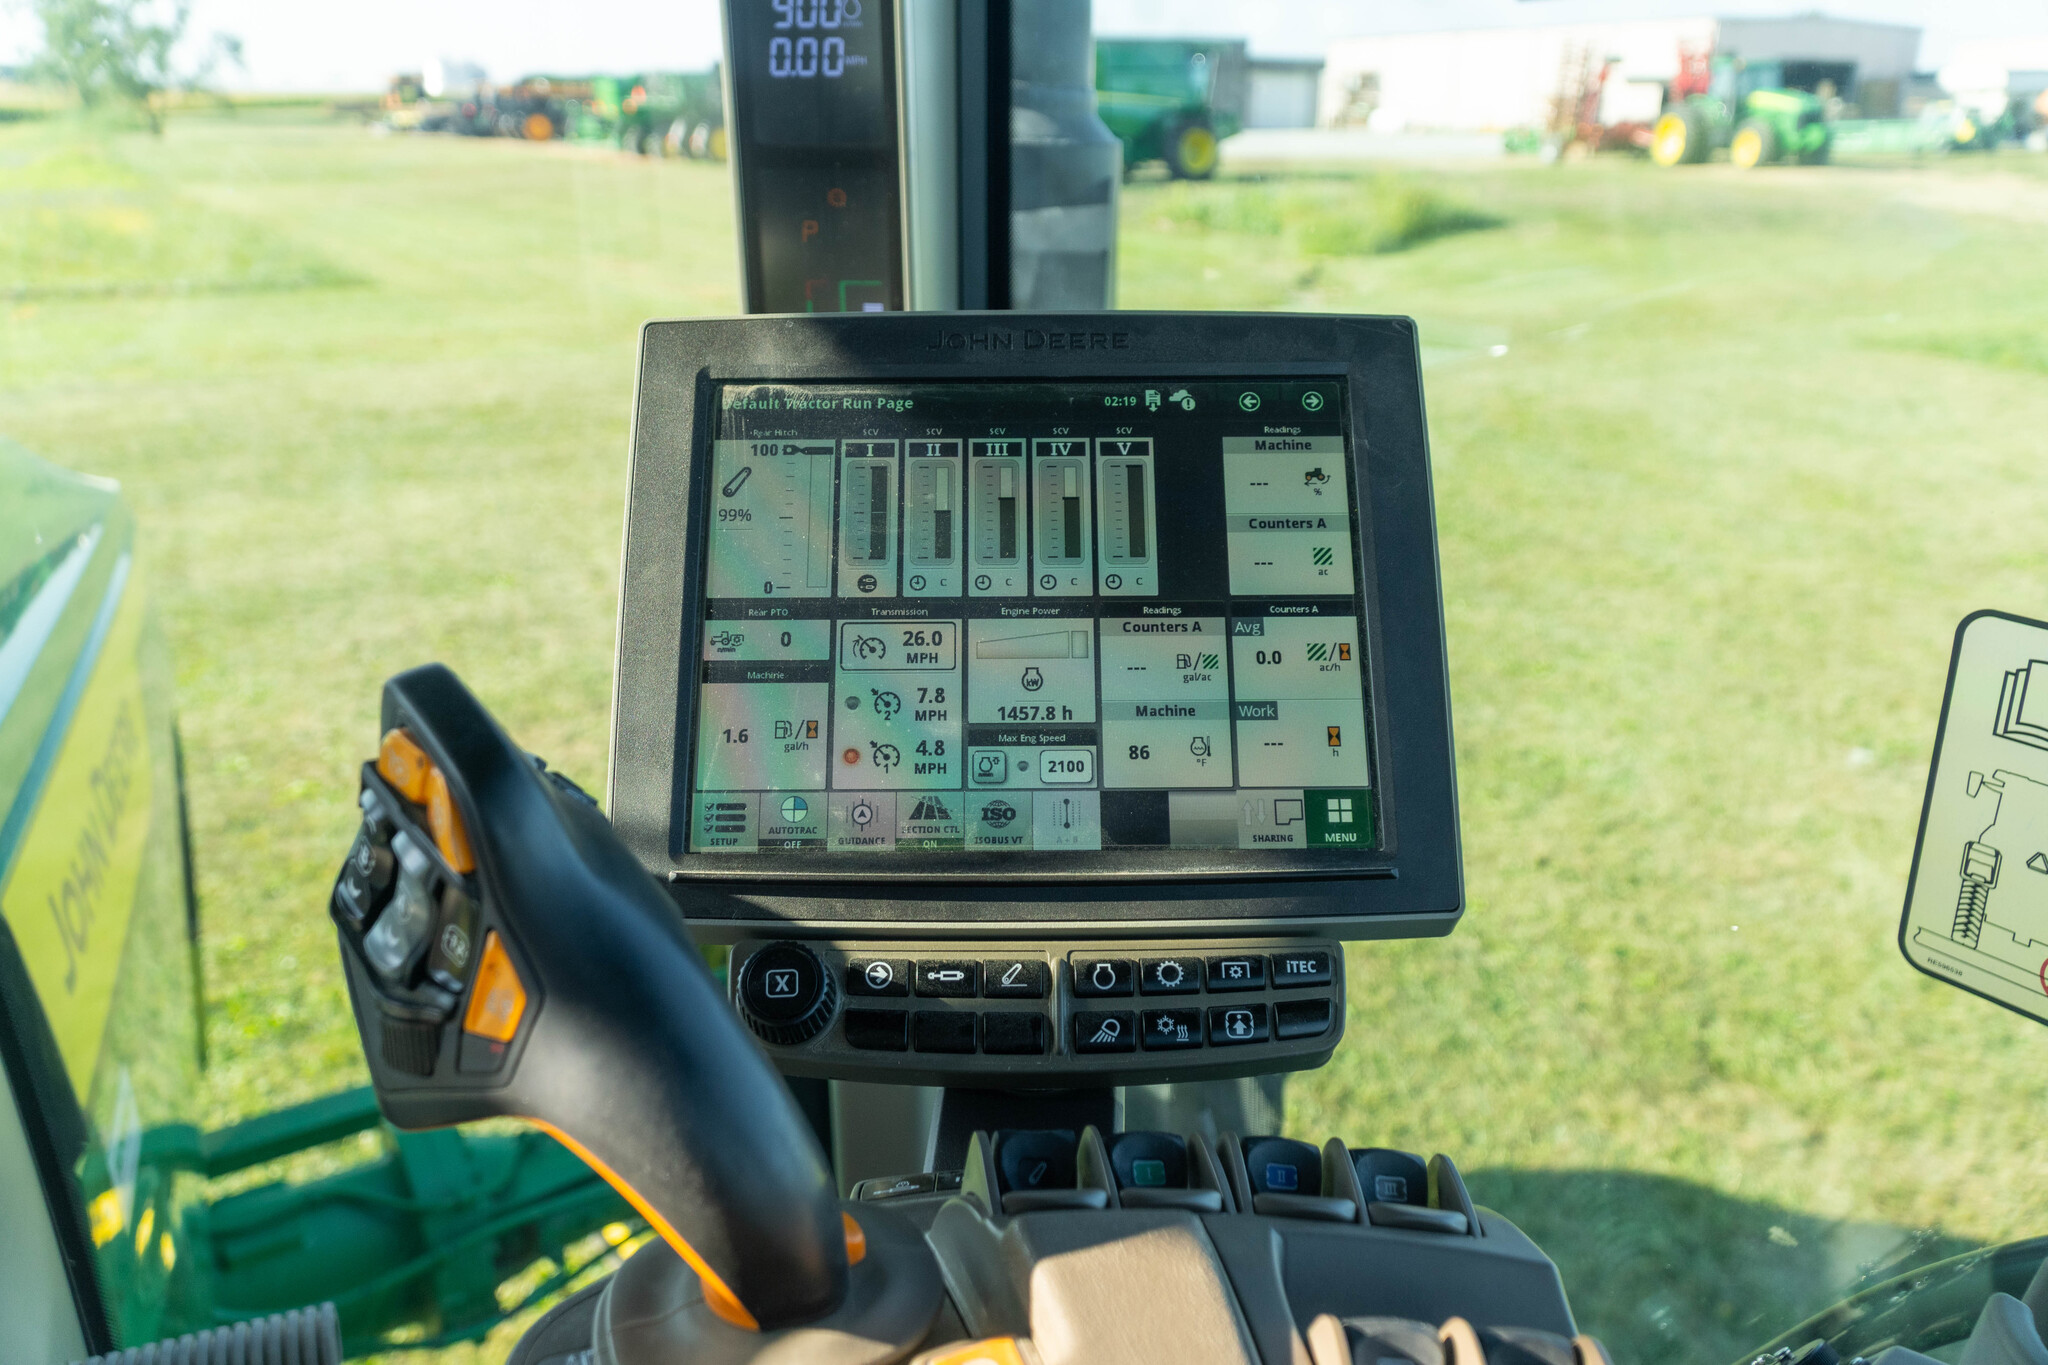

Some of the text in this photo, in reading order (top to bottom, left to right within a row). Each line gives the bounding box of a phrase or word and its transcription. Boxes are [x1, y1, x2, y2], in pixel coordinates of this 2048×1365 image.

[769, 37, 845, 77] 0.00
[801, 220, 819, 242] P
[927, 329, 1130, 350] JOHN DEERE
[843, 398, 872, 409] Run
[877, 398, 914, 412] Page
[1104, 396, 1136, 406] 02:19
[926, 428, 942, 436] SCV
[1052, 427, 1069, 435] SCV
[1116, 427, 1132, 435] SCV
[1264, 426, 1301, 435] Readings
[751, 444, 778, 456] 100
[926, 443, 941, 456] II
[986, 443, 1009, 456] III
[1050, 443, 1072, 455] IV
[1117, 443, 1131, 455] V
[1254, 440, 1312, 451] Machine
[719, 509, 752, 522] 99%
[1248, 517, 1327, 530] Counters A
[940, 579, 947, 587] C
[1005, 578, 1012, 587] C
[1071, 578, 1078, 586] C
[1136, 577, 1143, 586] C
[764, 581, 773, 594] 0
[749, 608, 788, 616] Rear PTO
[872, 607, 928, 617] Transmission
[1001, 608, 1030, 616] Engine
[1143, 605, 1182, 616] Readings
[1269, 605, 1319, 614] Counters A
[1122, 621, 1202, 634] Counters A
[1235, 621, 1260, 636] Avg
[781, 632, 791, 646] 0
[902, 631, 942, 646] 26.0
[907, 653, 938, 664] MPH
[1256, 651, 1282, 665] 0.0
[1319, 663, 1341, 672] ac/h
[747, 671, 785, 679] Machine
[1183, 672, 1212, 683] gal/ac
[917, 688, 945, 703] 7.8
[884, 710, 891, 721] 2
[915, 710, 947, 721] MPH
[998, 706, 1072, 721] 1457.8 h
[1135, 705, 1196, 717] Machine
[1239, 705, 1275, 717] Work
[723, 729, 749, 744] 1.6
[1021, 735, 1036, 744] Eng
[1039, 735, 1066, 744] Speed
[784, 741, 809, 752] gal/h
[916, 741, 945, 756] 4.8
[1129, 746, 1150, 760] 86
[1332, 748, 1339, 757] h
[884, 763, 890, 773] 1
[915, 763, 947, 774] MPH
[1048, 761, 1084, 773] 2100
[981, 807, 1016, 821] ISO
[769, 826, 817, 835] AUTOTRAC
[944, 825, 960, 833] CTL
[710, 838, 738, 846] SETUP
[838, 837, 885, 845] GUIDANCE
[1253, 834, 1293, 843] SHARING
[1325, 833, 1357, 842] MENU
[784, 840, 802, 849] OFF
[923, 840, 937, 848] ON
[1287, 960, 1316, 973] iTEC
[775, 975, 790, 992] X
